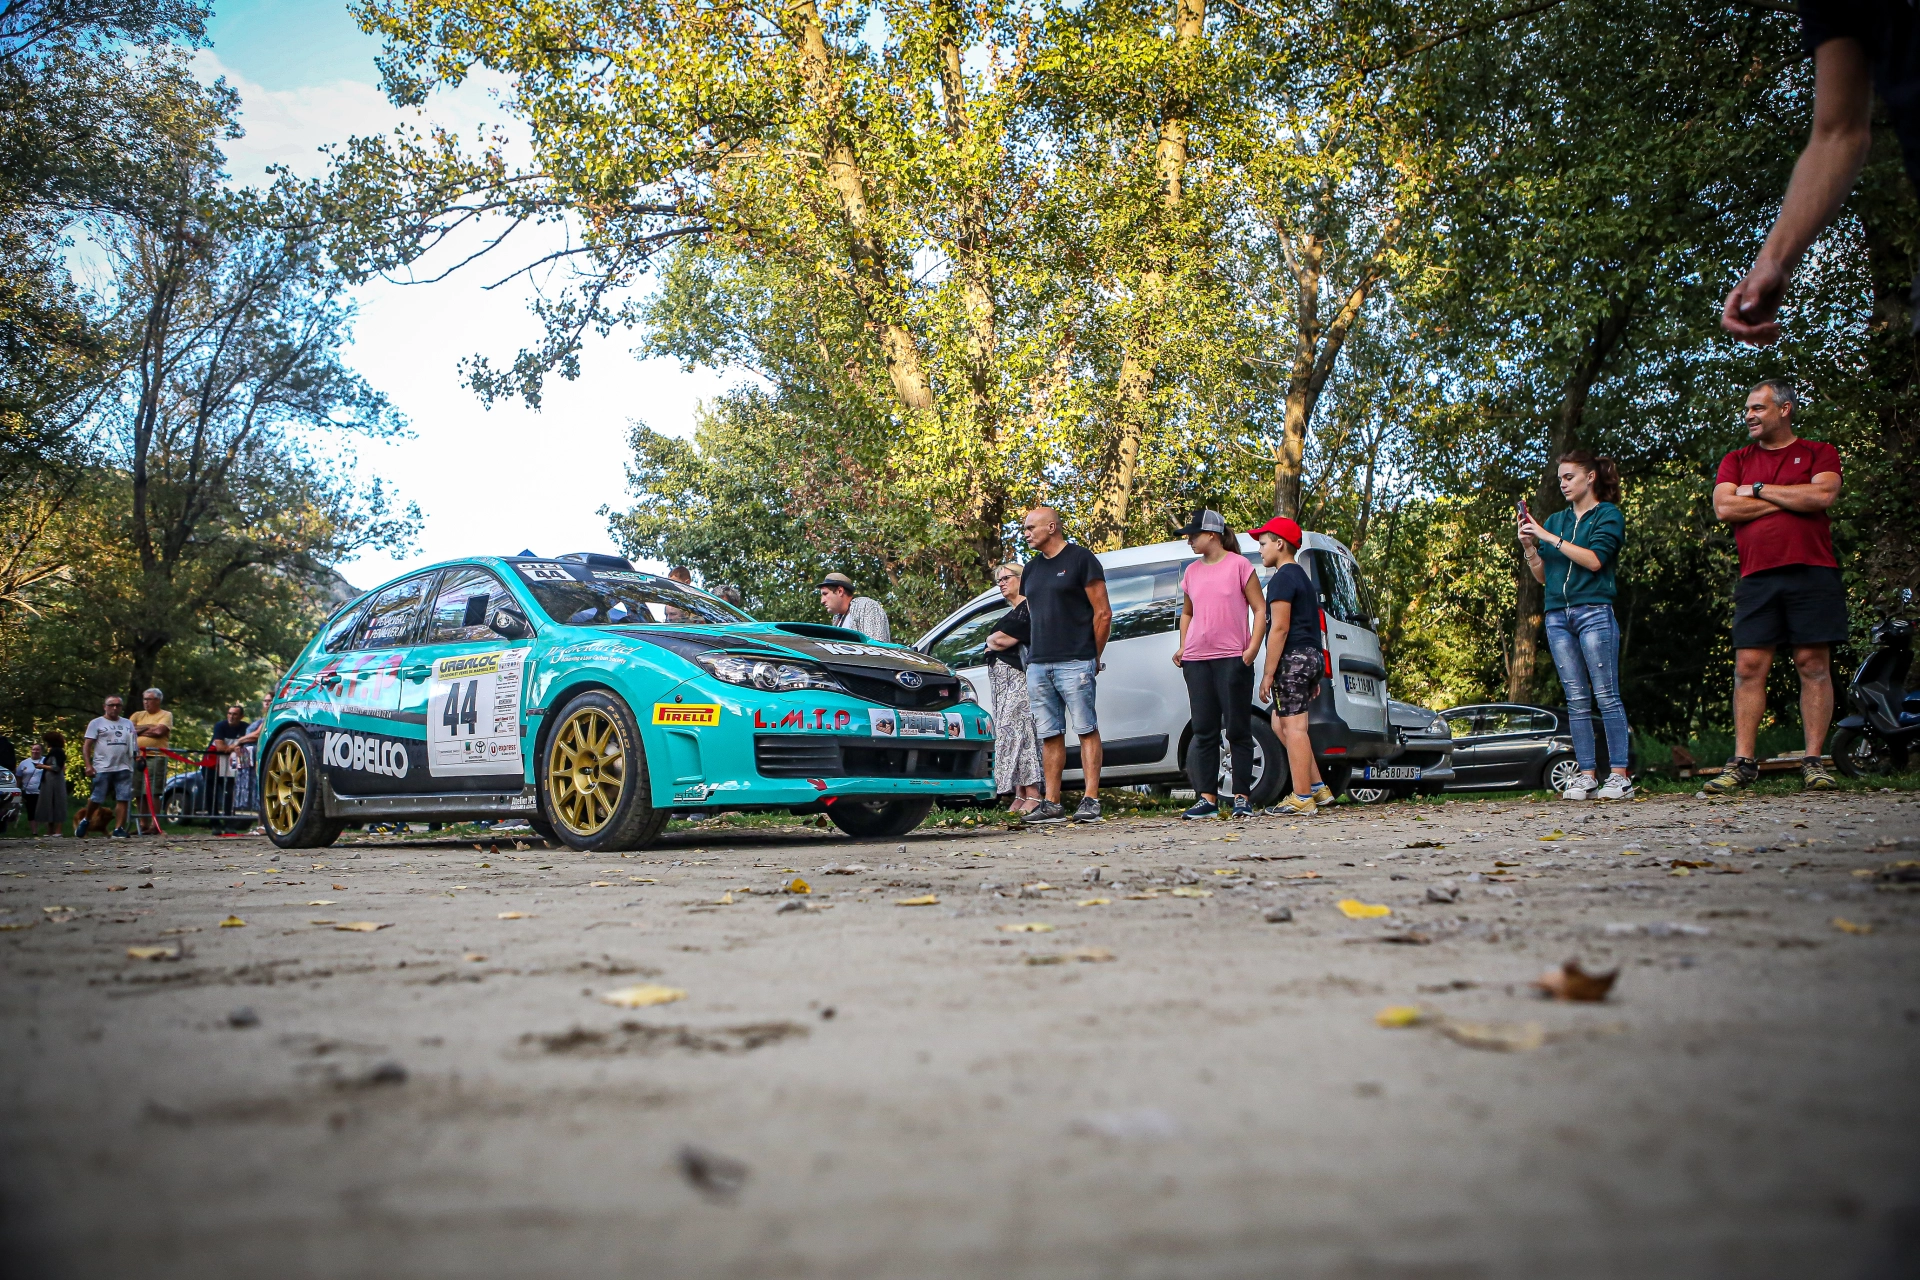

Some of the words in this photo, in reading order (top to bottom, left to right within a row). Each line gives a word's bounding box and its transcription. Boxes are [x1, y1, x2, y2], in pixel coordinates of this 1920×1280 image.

[534, 570, 567, 580] 44
[439, 654, 501, 673] URBALOC
[443, 679, 479, 737] 44
[658, 707, 714, 722] PIRELLI
[754, 708, 851, 730] L.M.T.P
[323, 731, 409, 779] KOBELCO
